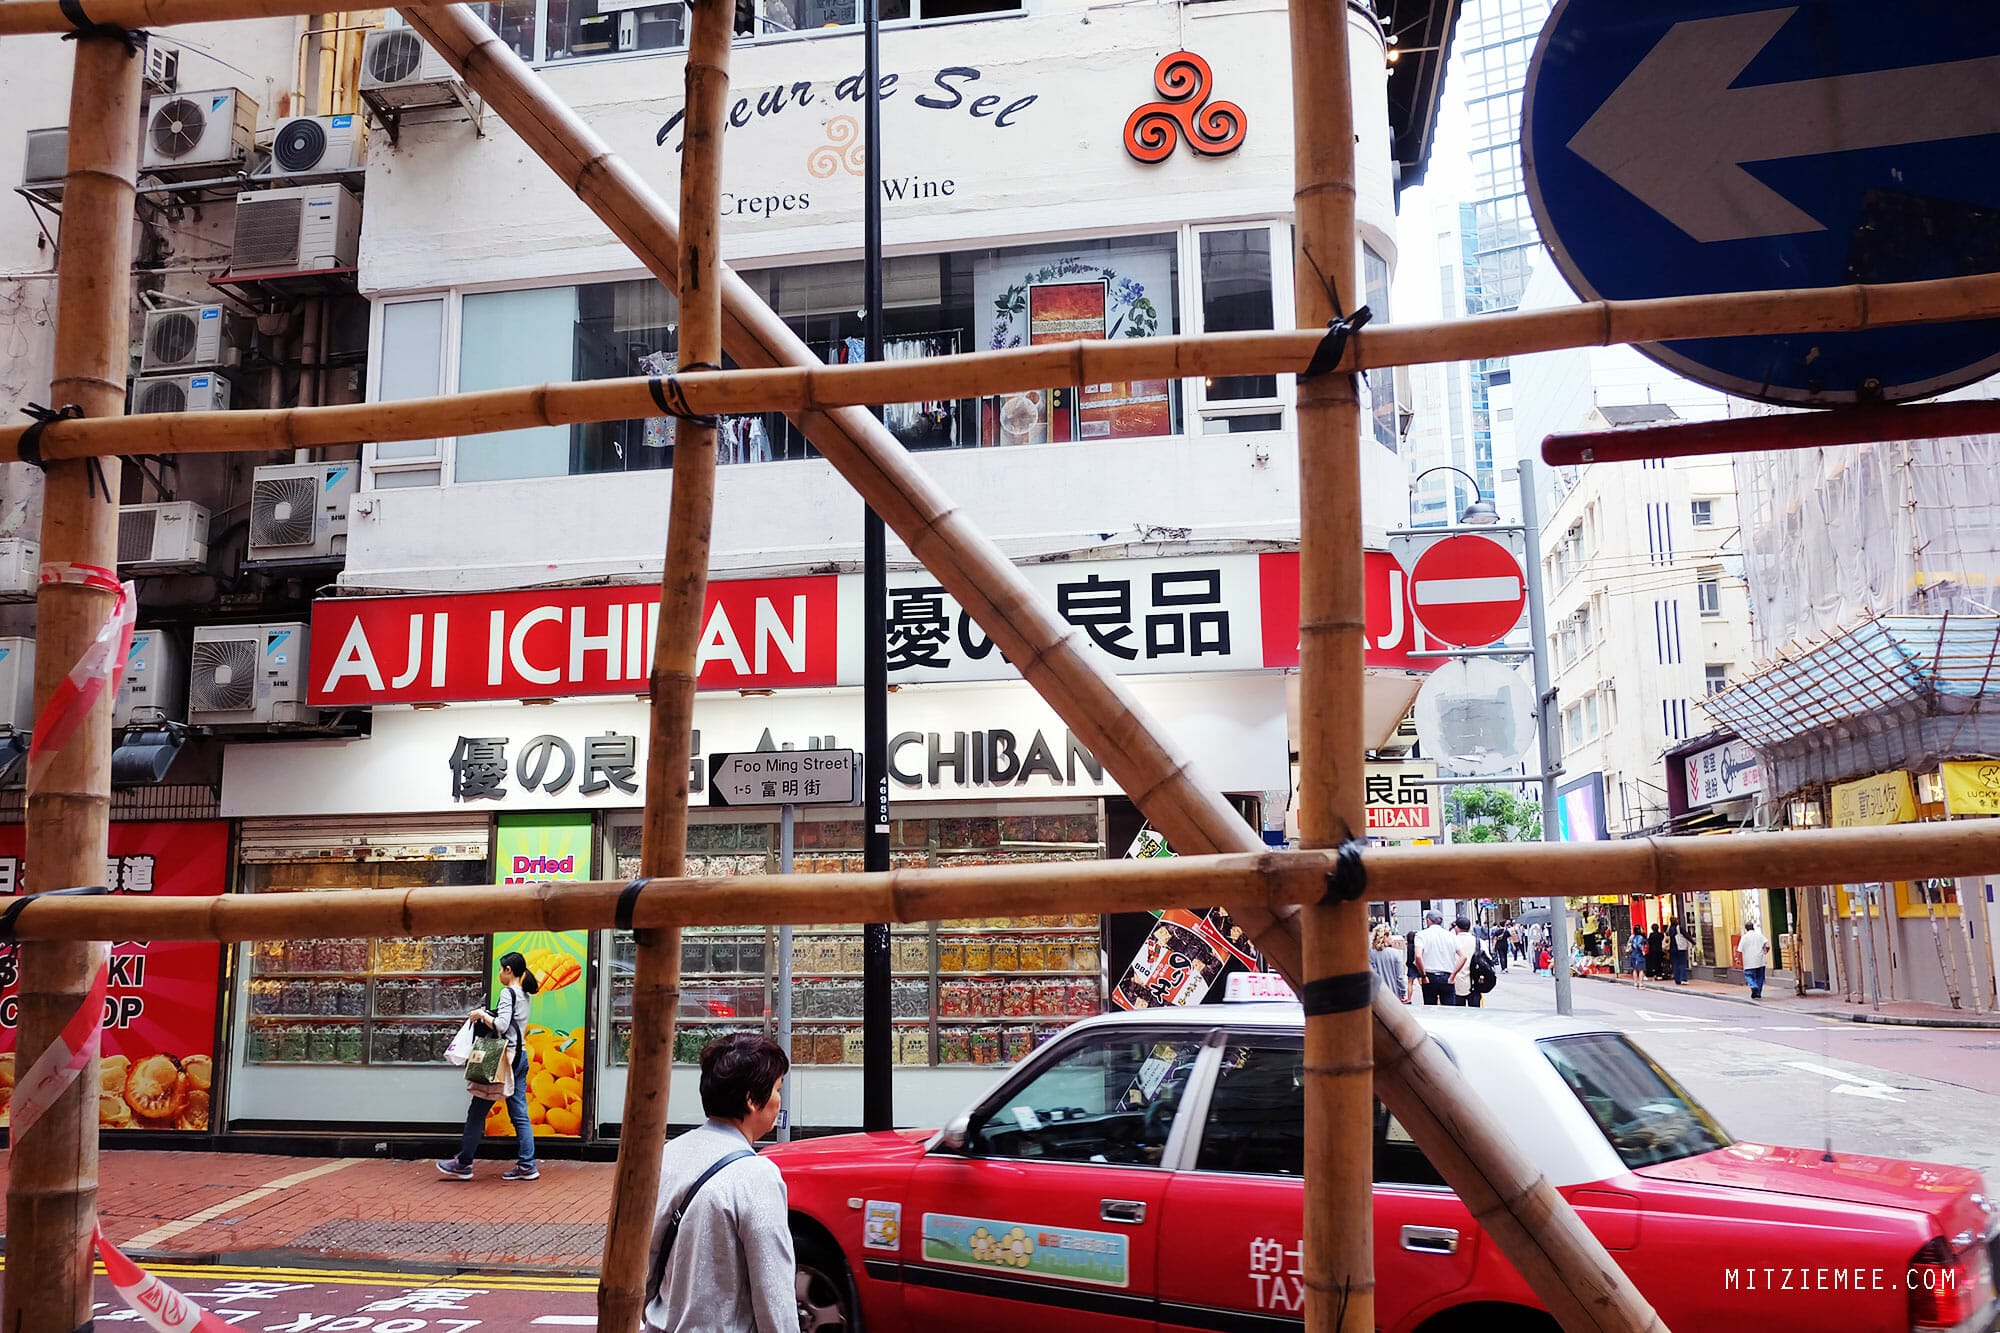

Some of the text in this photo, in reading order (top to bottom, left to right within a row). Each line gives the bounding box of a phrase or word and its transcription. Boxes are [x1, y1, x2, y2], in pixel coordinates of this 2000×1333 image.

[915, 66, 1039, 128] Sel
[881, 175, 956, 201] Wine
[321, 613, 449, 693] AJI
[734, 757, 848, 773] Foo Ming Street
[734, 779, 821, 798] 1-5 富明街
[879, 776, 889, 823] 46950
[512, 855, 575, 874] Dried
